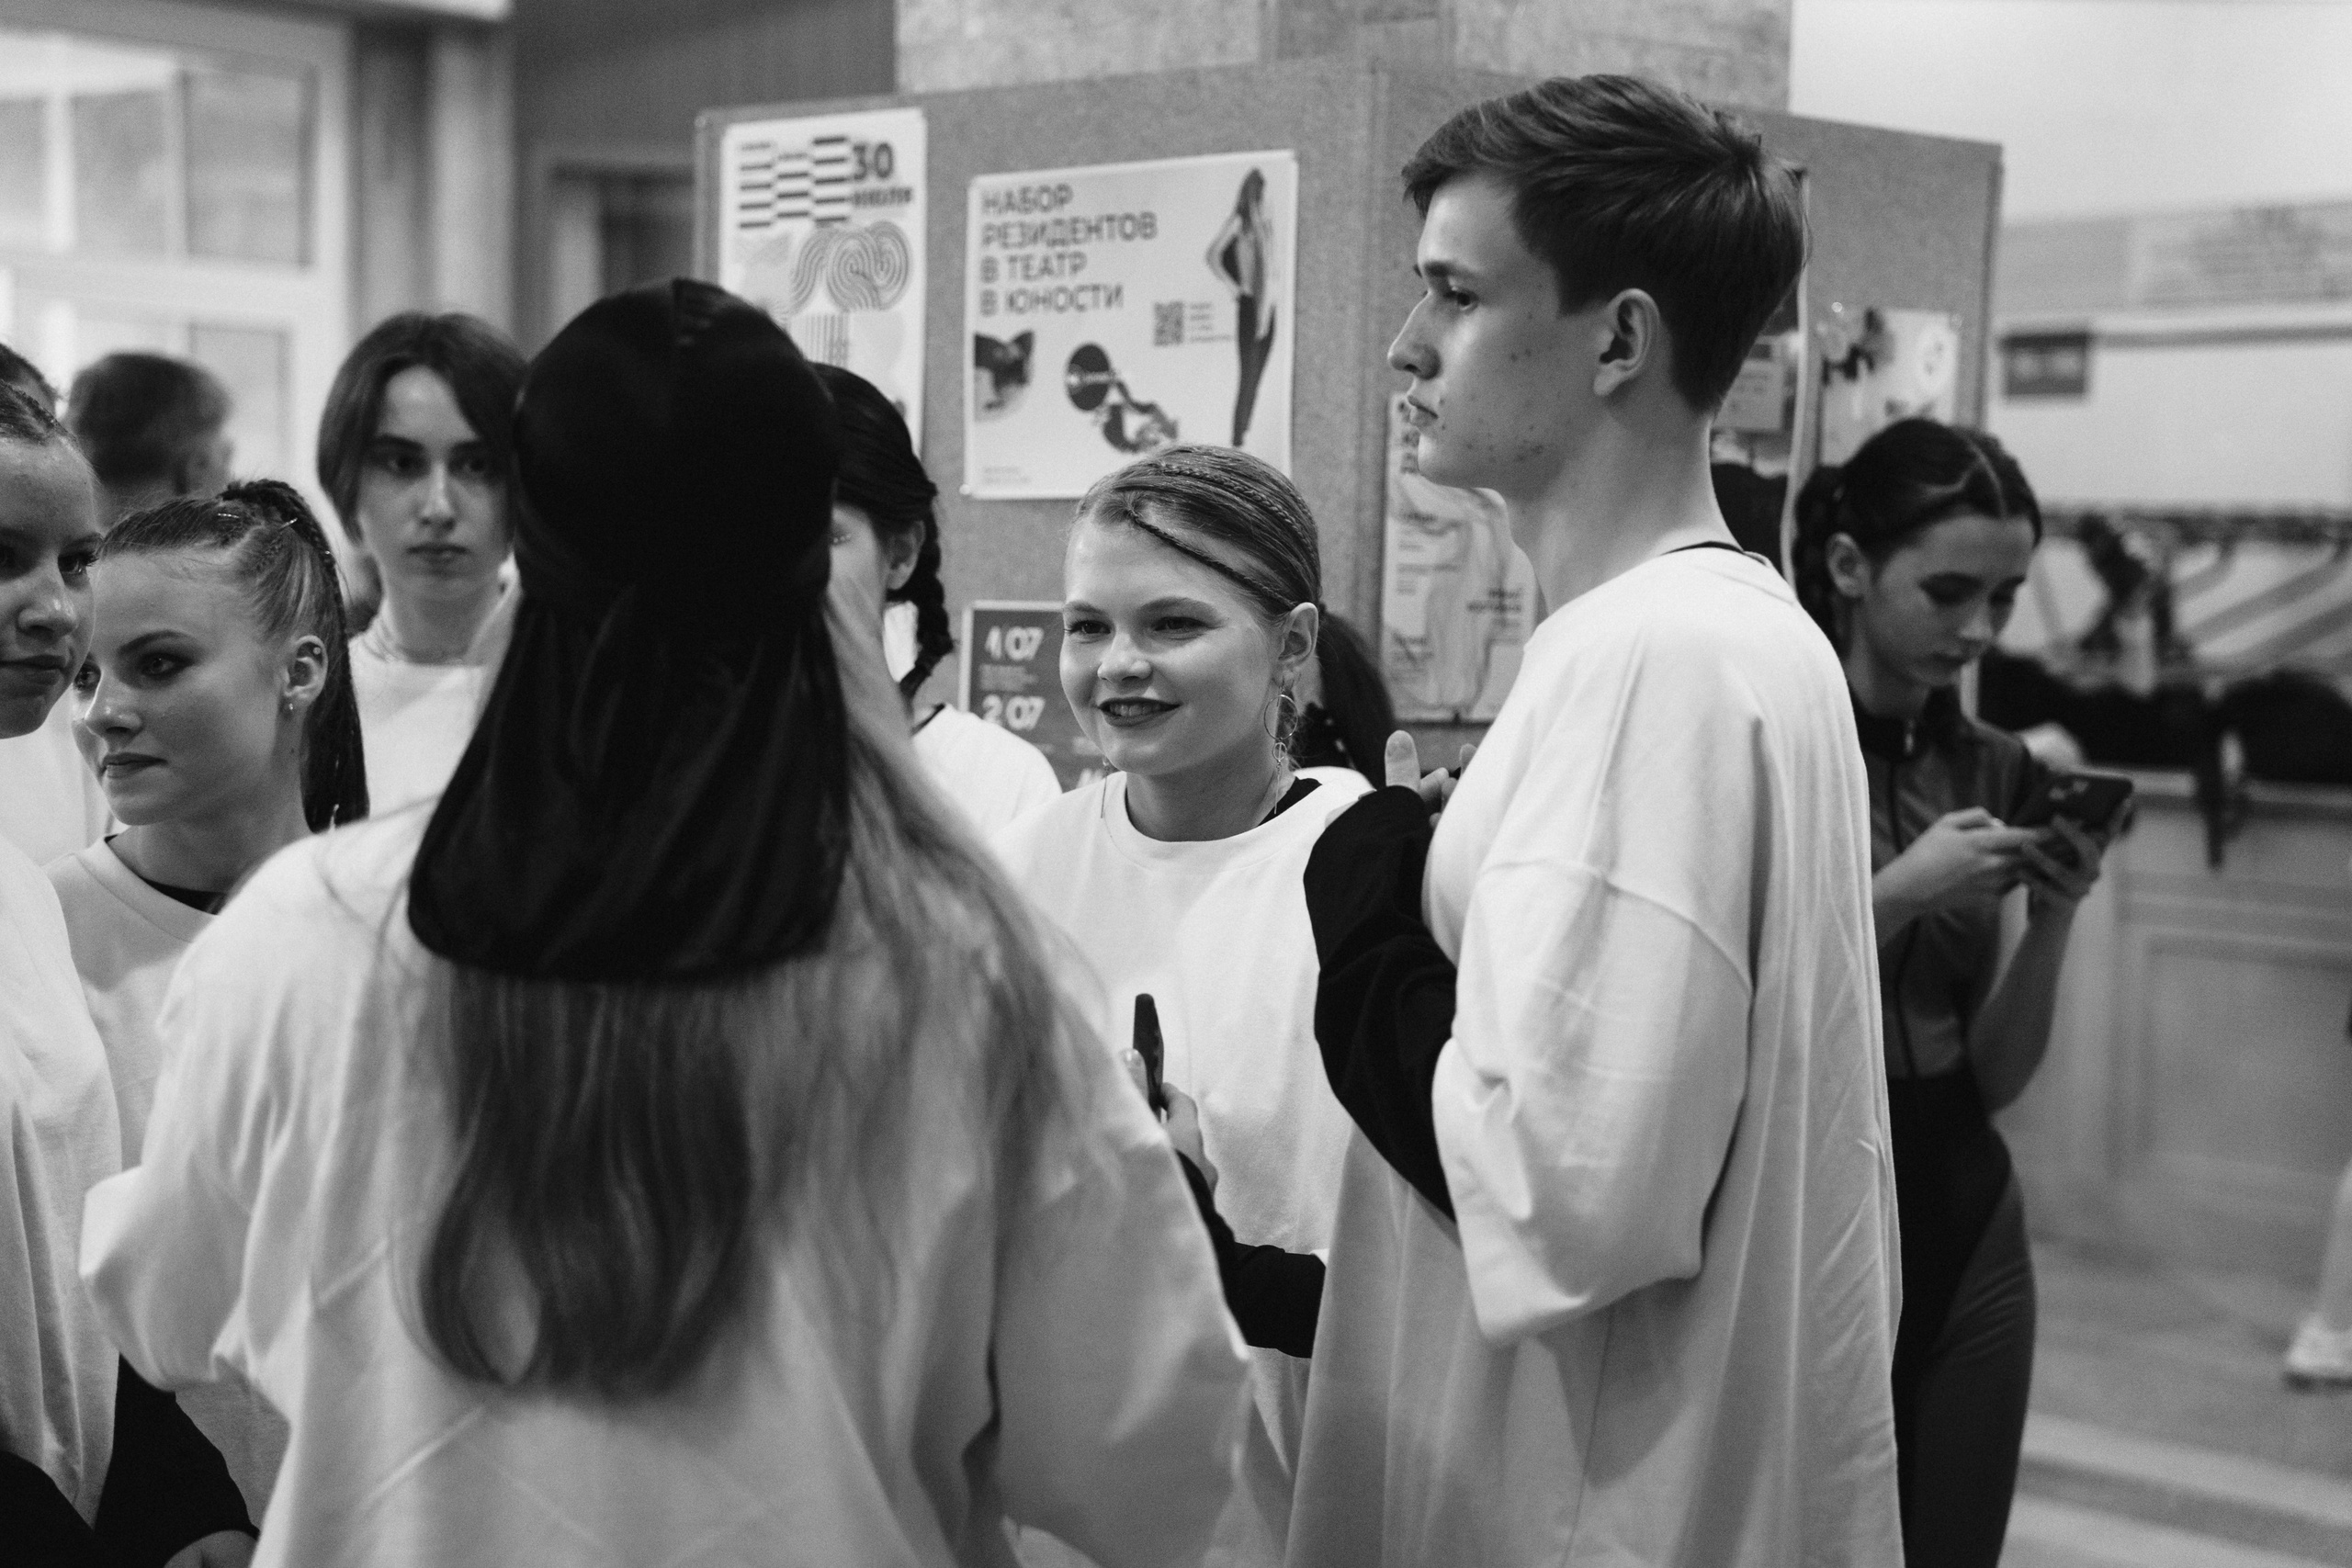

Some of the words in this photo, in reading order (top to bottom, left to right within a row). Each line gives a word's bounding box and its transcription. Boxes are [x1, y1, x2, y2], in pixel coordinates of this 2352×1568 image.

[852, 141, 895, 181] 30
[980, 183, 1074, 214] НАБОР
[980, 210, 1159, 249] РЕЗИДЕНТОВ
[979, 254, 1000, 284] В
[1008, 250, 1089, 282] ТЕАТР
[979, 288, 999, 318] В
[1006, 282, 1125, 315] ЮНОСТИ
